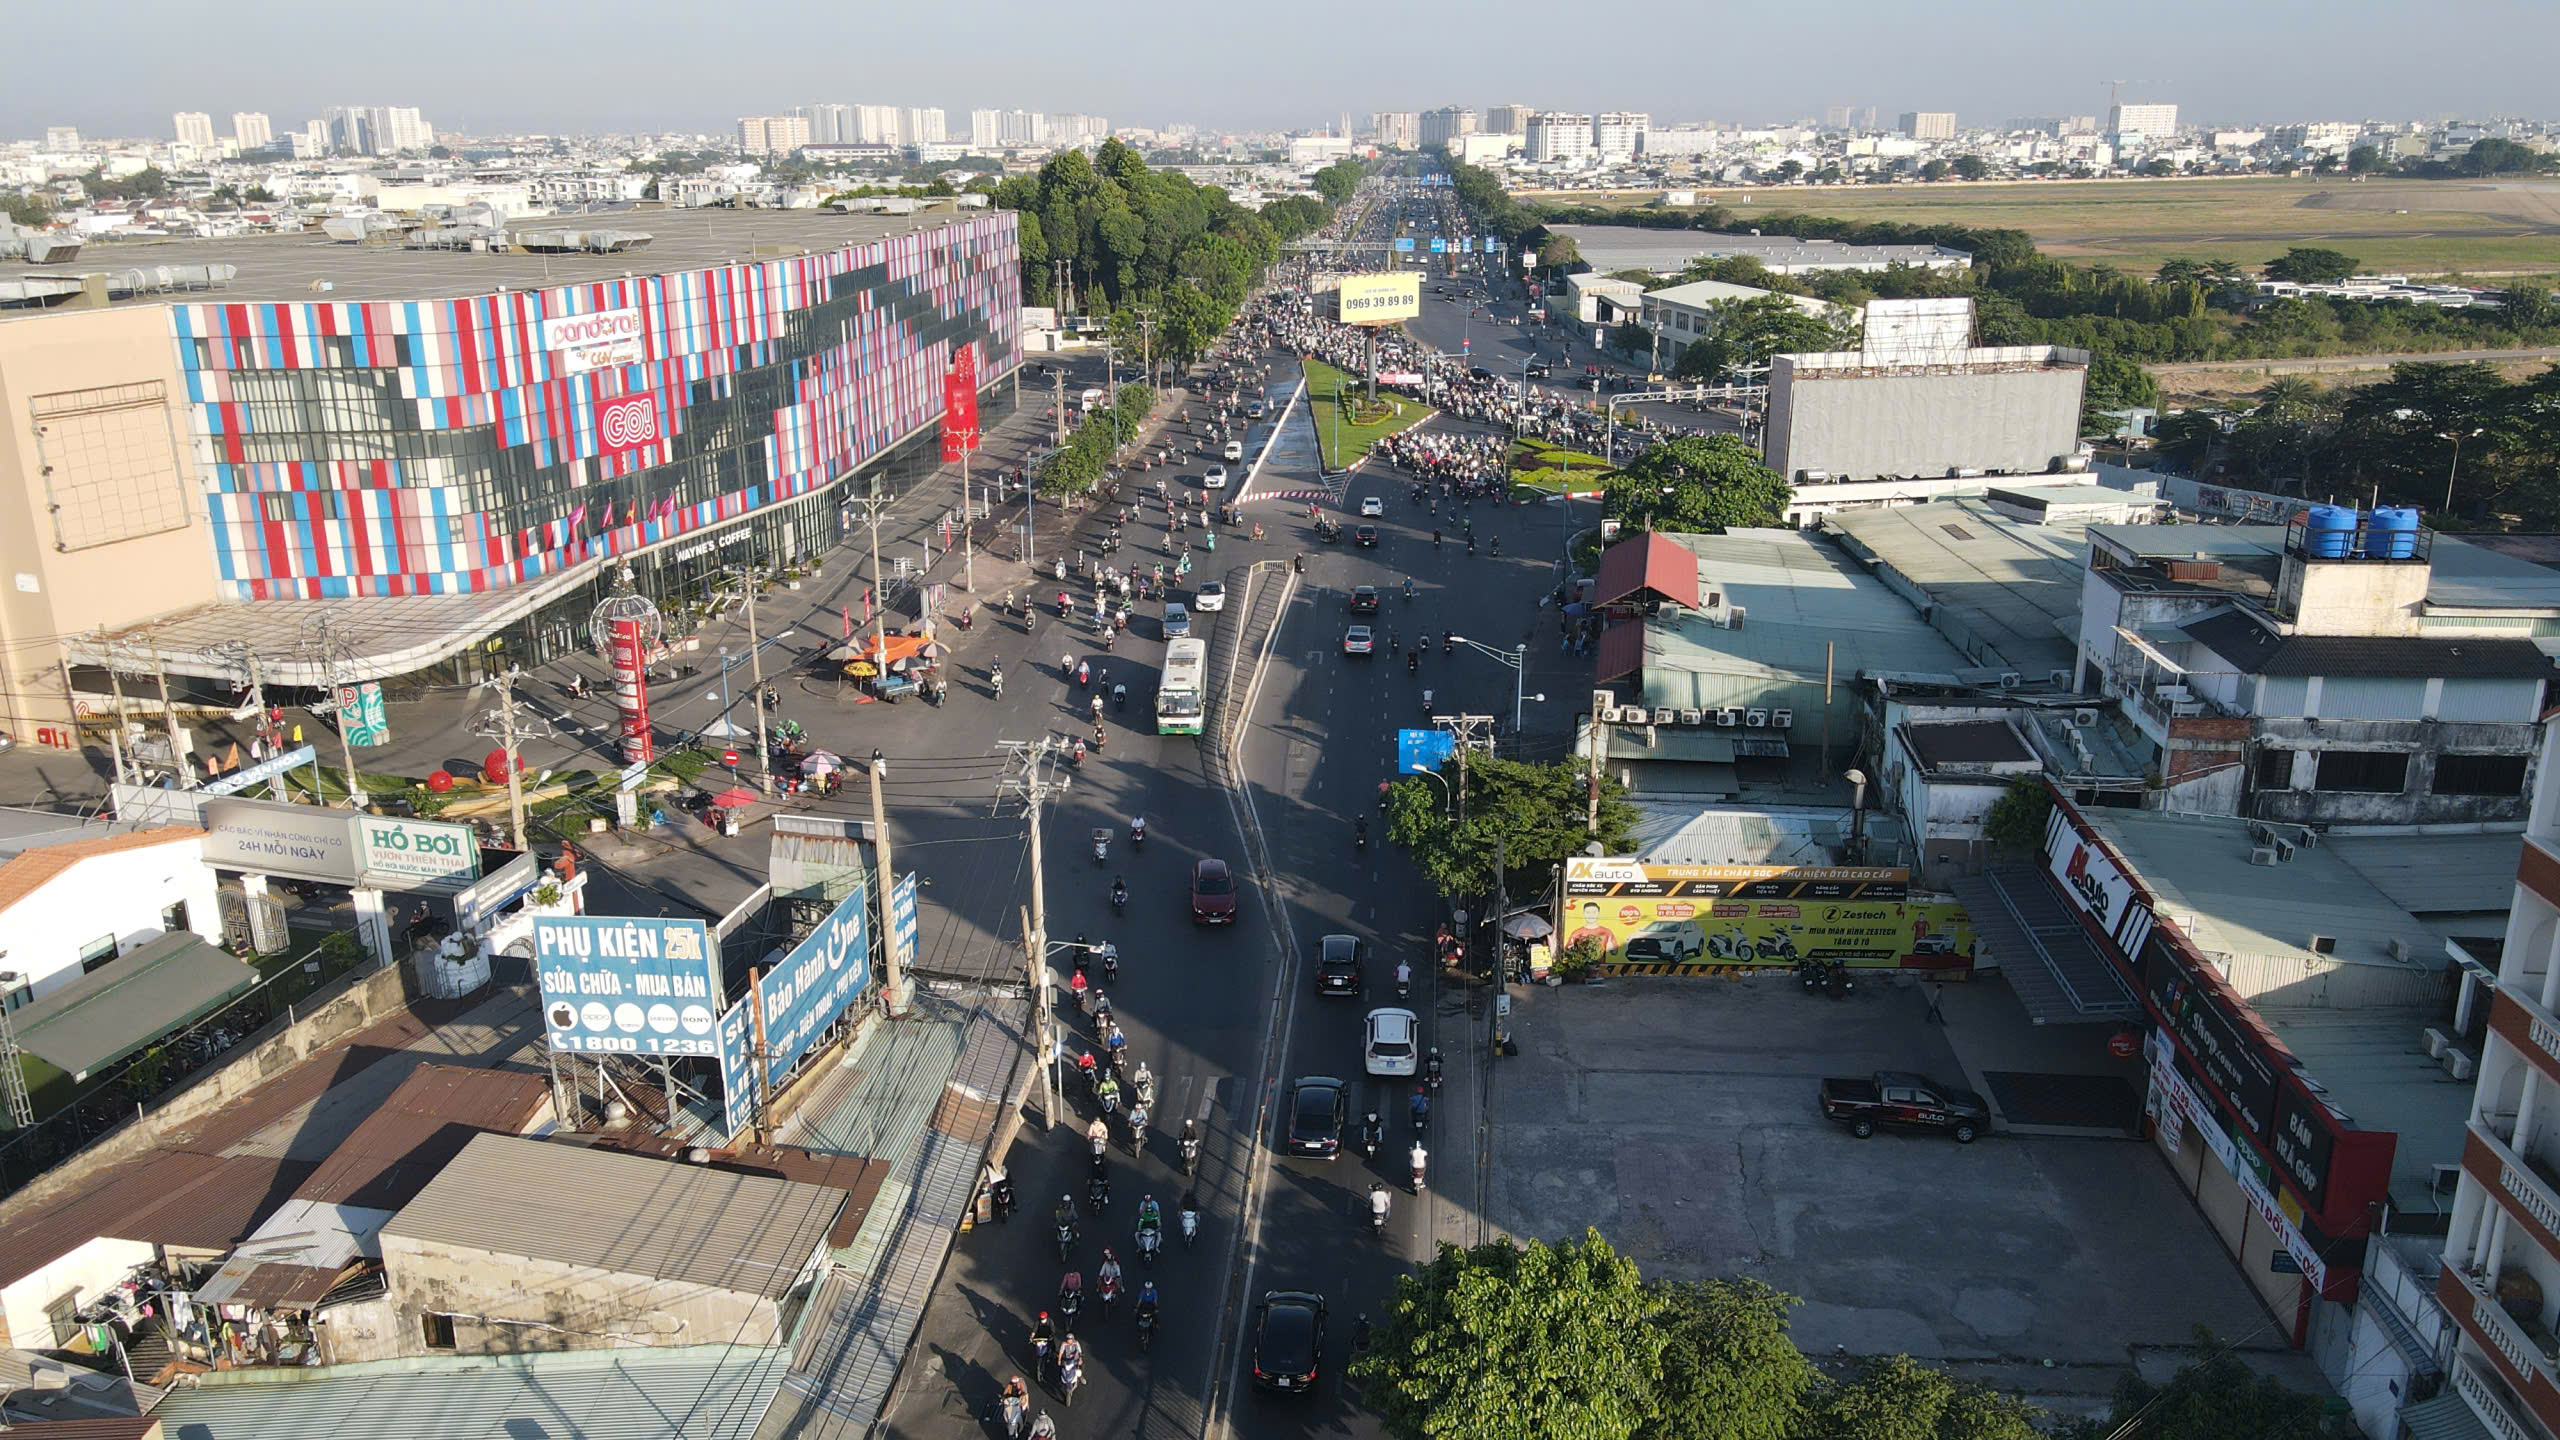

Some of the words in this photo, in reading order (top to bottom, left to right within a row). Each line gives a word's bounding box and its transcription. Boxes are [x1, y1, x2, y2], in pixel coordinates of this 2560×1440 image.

[1346, 298, 1370, 310] 0969
[1373, 296, 1385, 308] 39
[1388, 295, 1400, 306] 89
[1402, 294, 1414, 305] 89
[554, 313, 632, 345] pandora
[591, 351, 612, 366] CGV
[603, 398, 655, 447] GO!
[676, 540, 715, 562] WAYNE'S
[719, 527, 752, 547] COFFEE
[239, 840, 261, 852] 24H
[290, 845, 325, 860] NGÀY
[371, 824, 409, 851] HỒ
[413, 833, 461, 856] BƠI
[1667, 868, 1699, 877] TRUNG
[1702, 867, 1721, 877] TÂM
[1753, 868, 1773, 878] SÓC
[1782, 870, 1800, 880] PHỤ
[1851, 871, 1871, 879] CAO
[1873, 869, 1892, 879] CẤP
[1842, 910, 1886, 920] Zestech
[539, 926, 591, 963] PHỤ
[598, 921, 658, 964] KIỆN
[544, 965, 576, 994] SỬA
[580, 968, 622, 995] CHỮA
[635, 974, 670, 997] MUA
[672, 970, 706, 997] BÁN
[768, 982, 792, 1025] Bảo
[795, 947, 825, 998] Hành
[569, 1035, 637, 1051] 1800
[647, 1038, 715, 1053] 1236
[1918, 1112, 1945, 1121] auto
[2289, 1111, 2313, 1150] BÁN
[2237, 1136, 2260, 1168] oppo
[2276, 1133, 2294, 1169] TRẢ
[2295, 1159, 2317, 1192] GÓP
